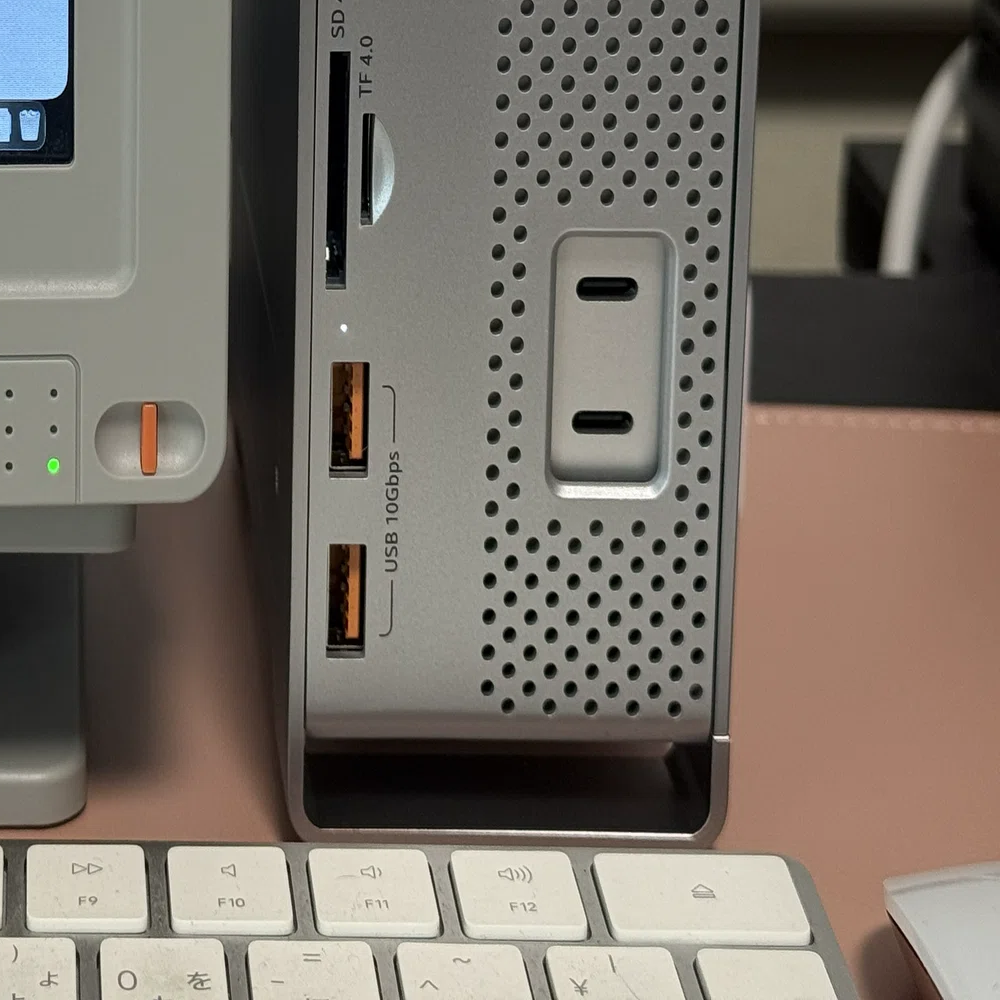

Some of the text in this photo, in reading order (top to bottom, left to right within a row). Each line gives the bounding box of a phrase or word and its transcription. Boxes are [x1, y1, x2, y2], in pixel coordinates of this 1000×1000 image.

[331, 9, 345, 39] SD
[358, 35, 373, 98] TF 4.0
[385, 451, 403, 573] USB 10Gbps
[78, 895, 98, 906] F9
[218, 897, 246, 908] F10
[364, 898, 390, 910] F11
[509, 901, 538, 912] F12
[11, 944, 19, 963] )
[302, 953, 322, 962] =
[39, 970, 59, 987] よ
[117, 970, 138, 991] 0
[186, 971, 212, 990] を
[569, 977, 588, 996] ¥
